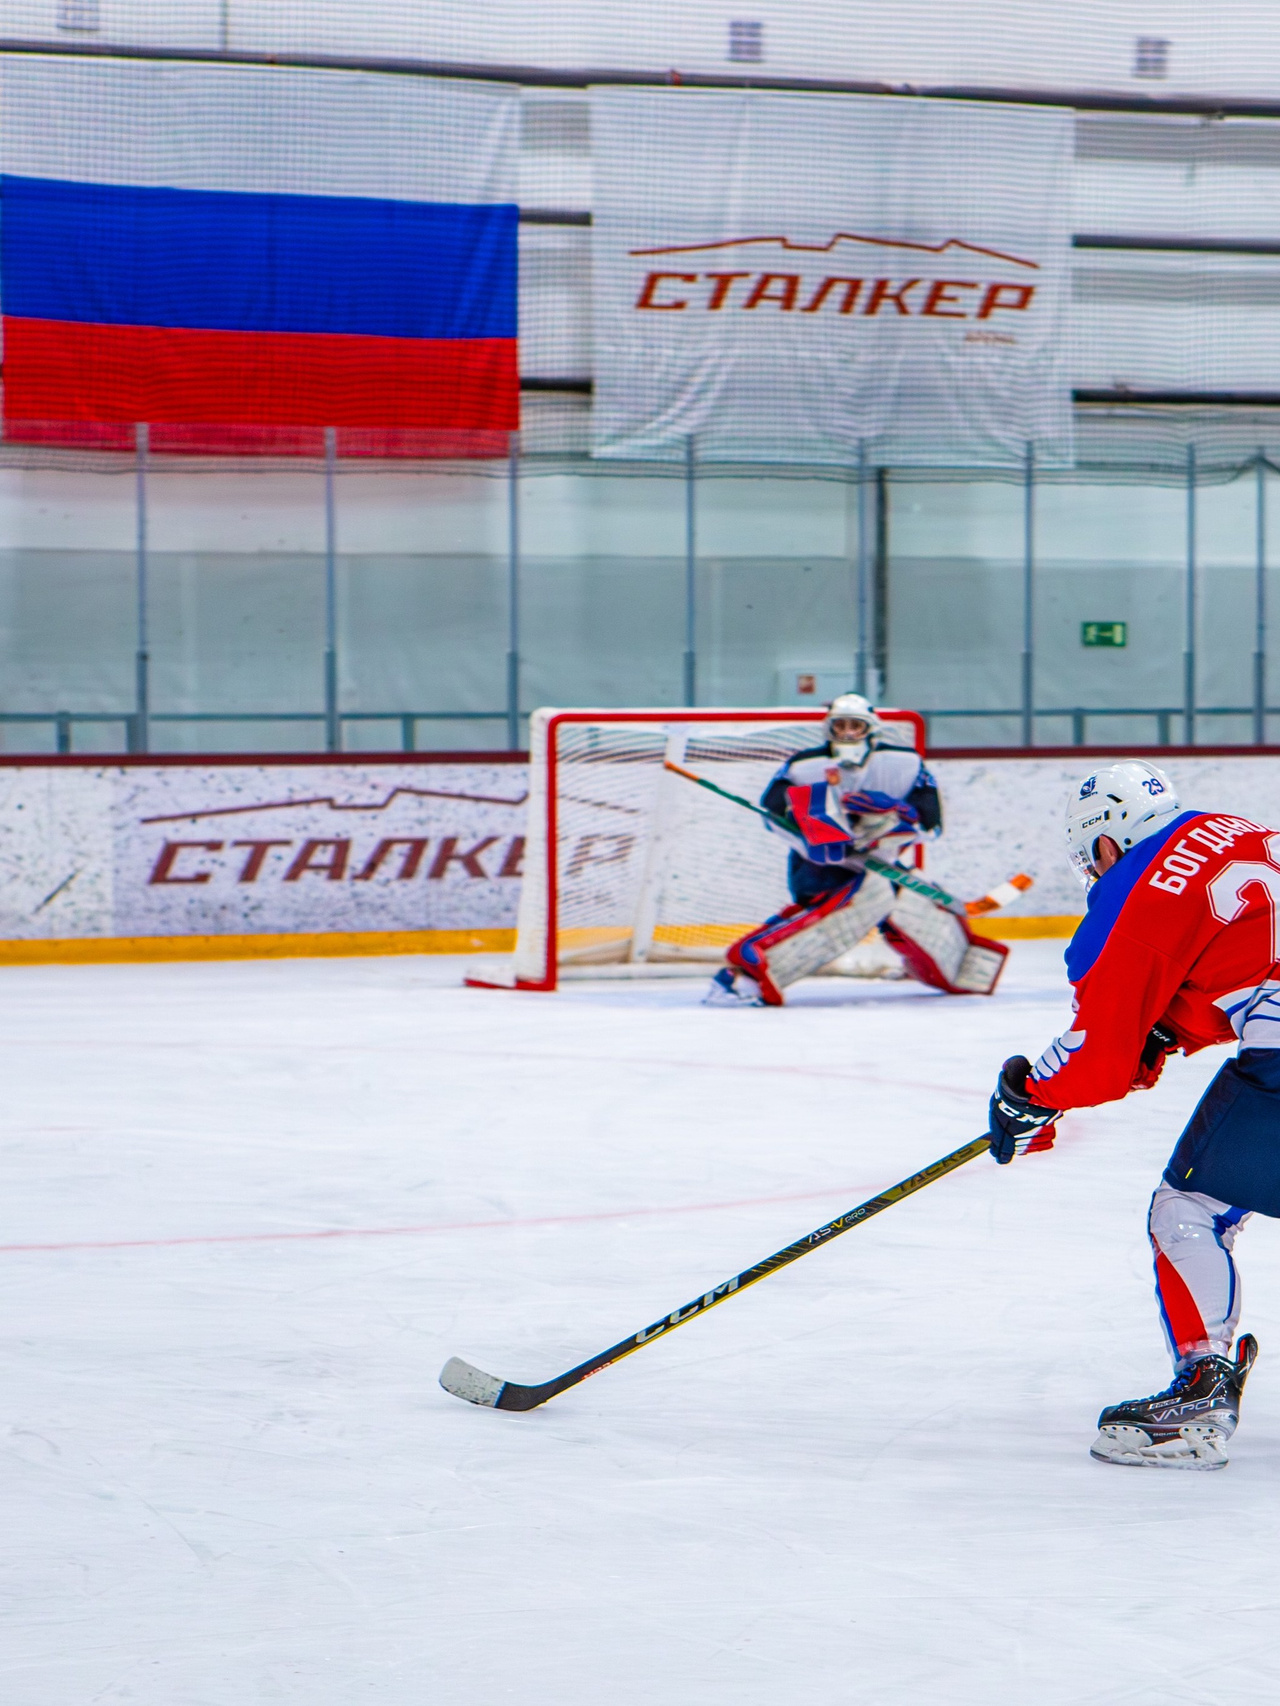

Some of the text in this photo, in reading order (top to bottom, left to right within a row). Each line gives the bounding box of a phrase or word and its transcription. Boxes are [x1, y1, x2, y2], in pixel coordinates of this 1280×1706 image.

[635, 271, 1036, 319] СТАЛКЕР
[1142, 778, 1165, 796] 29
[1082, 815, 1102, 829] CCM
[1148, 816, 1272, 896] БОГДАНО
[994, 1090, 1049, 1125] CM
[898, 1147, 974, 1192] TACKS
[636, 1275, 739, 1344] CCM
[1146, 1397, 1230, 1422] VAPOR
